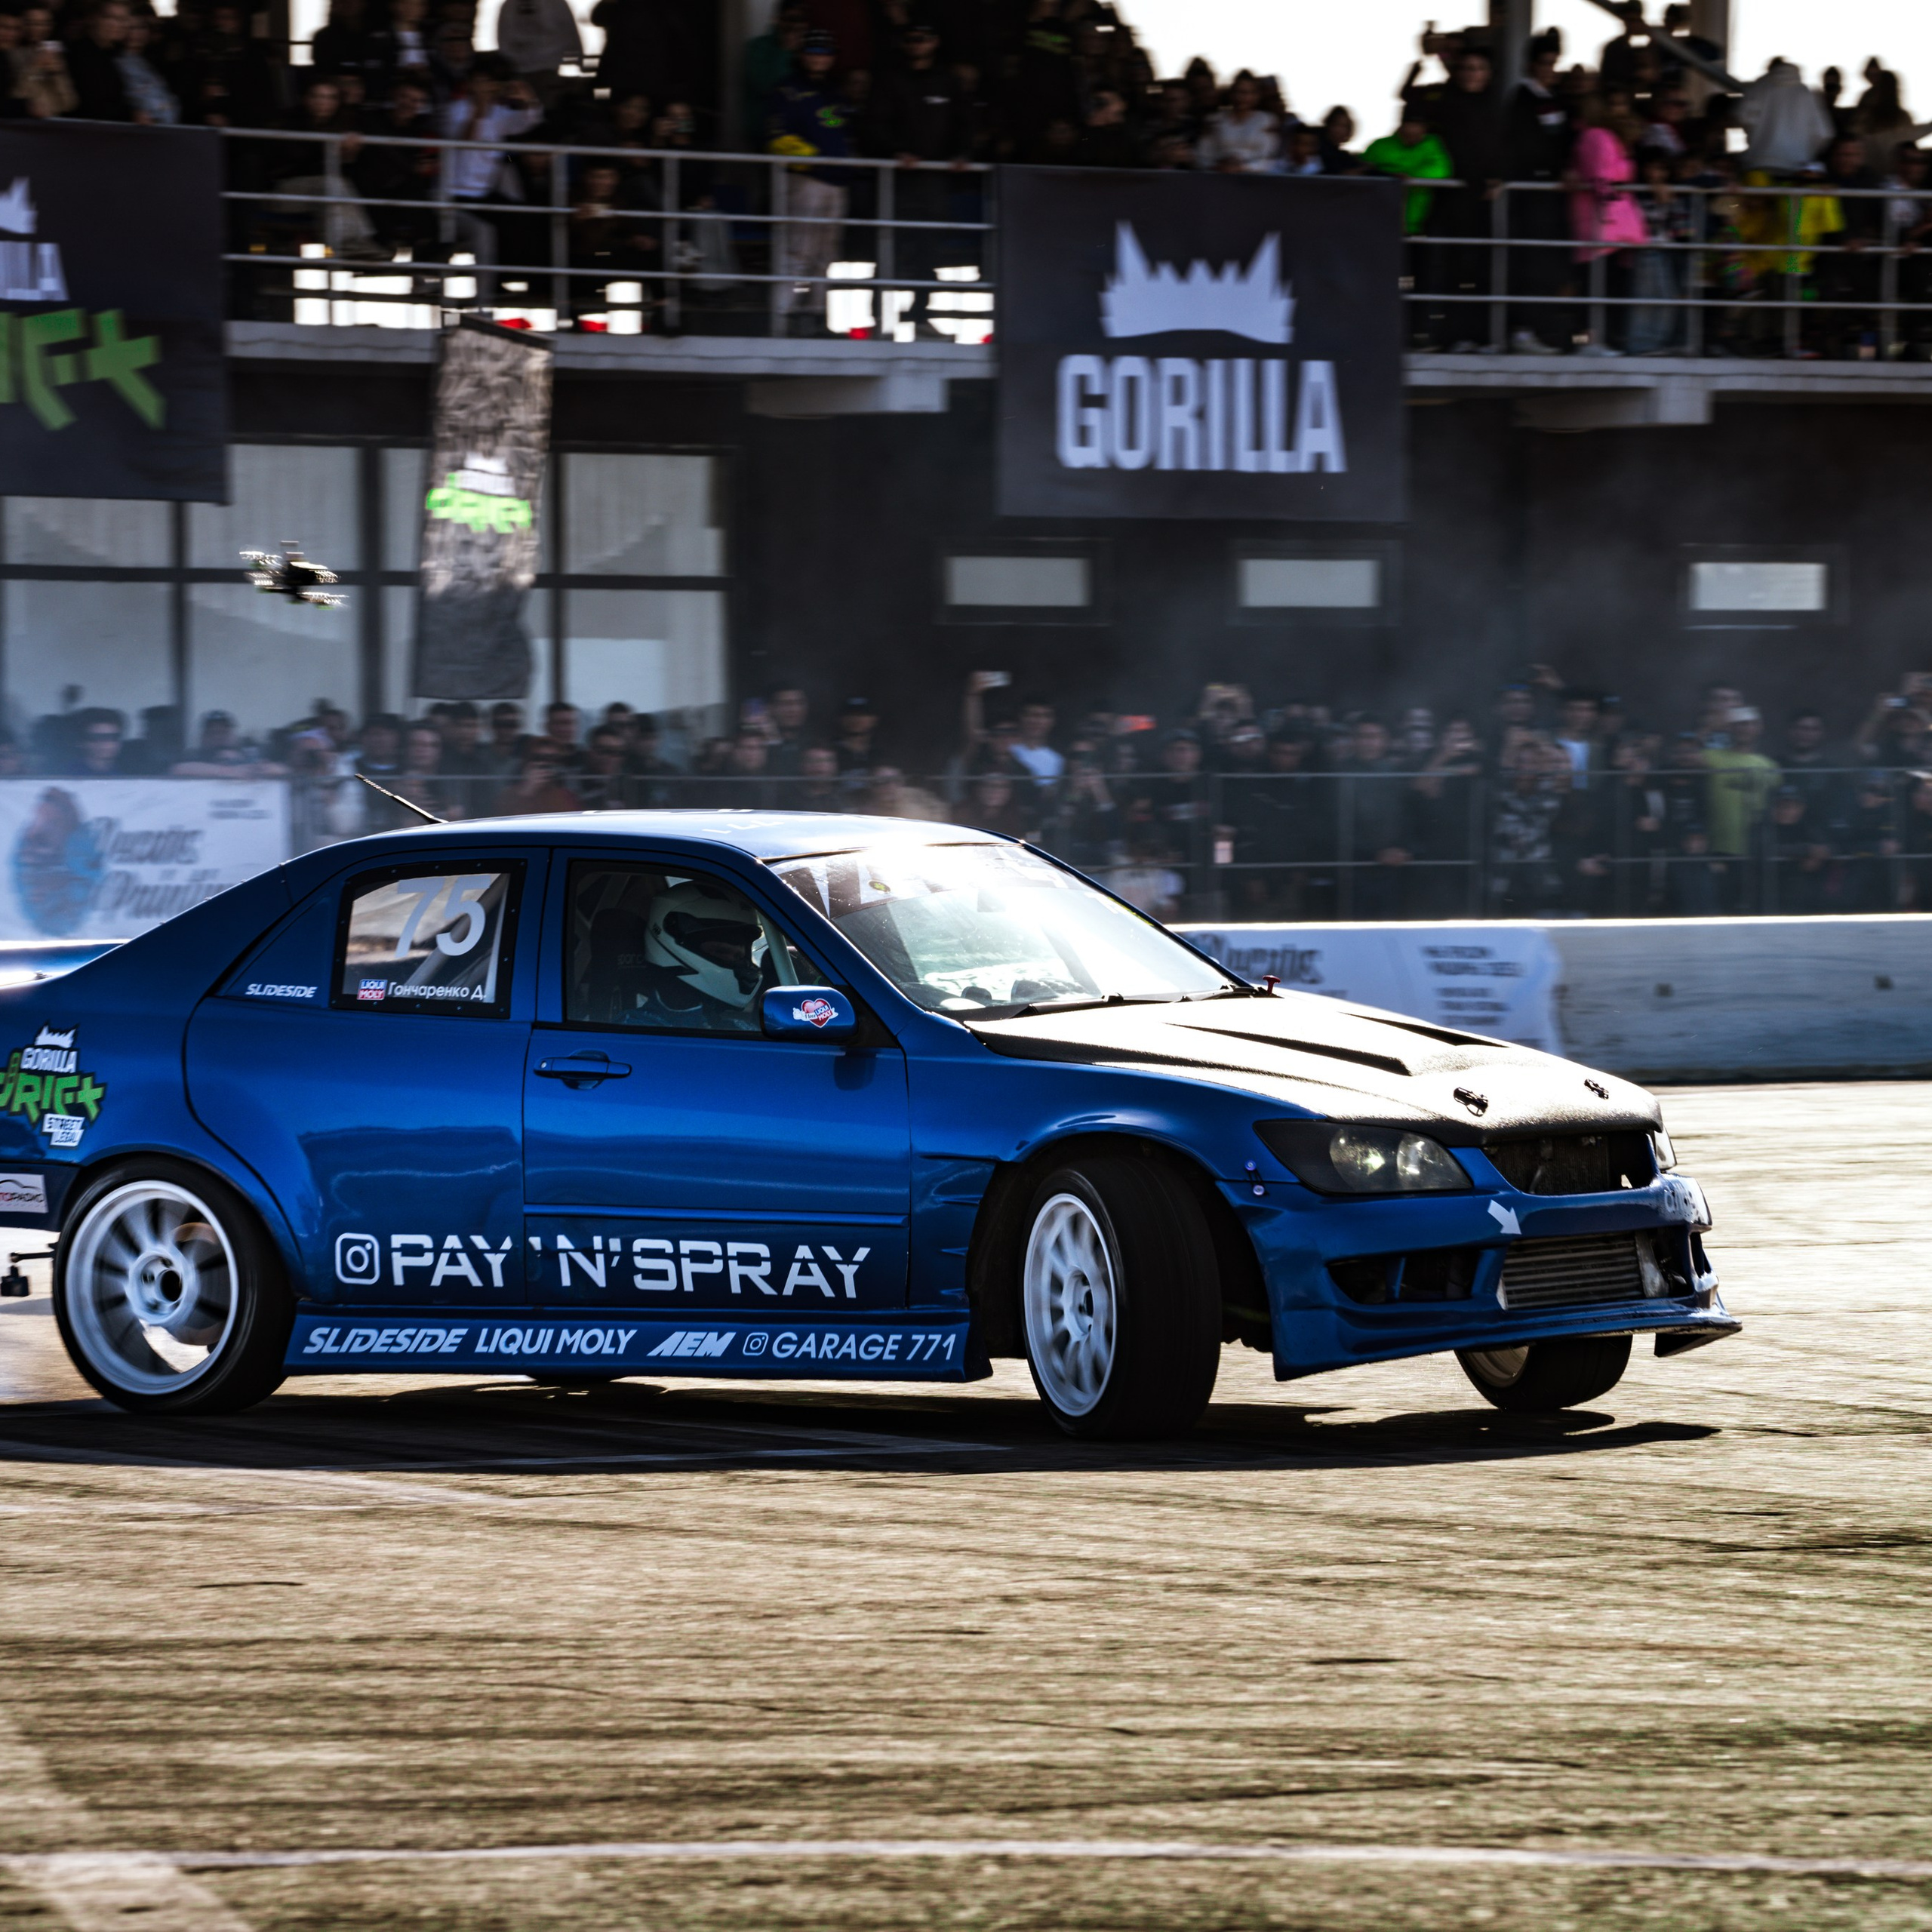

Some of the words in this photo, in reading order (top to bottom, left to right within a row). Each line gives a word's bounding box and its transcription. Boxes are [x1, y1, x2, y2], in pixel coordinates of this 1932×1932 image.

[1057, 354, 1349, 473] GORILLA
[395, 875, 491, 957] 75
[245, 983, 318, 998] SLIDESIDE
[358, 989, 383, 998] MOLY
[361, 980, 385, 990] LIQUI
[388, 982, 469, 998] Гончаренко
[20, 1047, 78, 1073] GORILLA
[302, 1327, 469, 1354] SLIDESIDE
[474, 1327, 555, 1356] LIQUI
[555, 1328, 638, 1355] MOLY
[647, 1331, 737, 1357] AEM
[772, 1331, 903, 1360] GARAGE
[906, 1333, 957, 1360] 771
